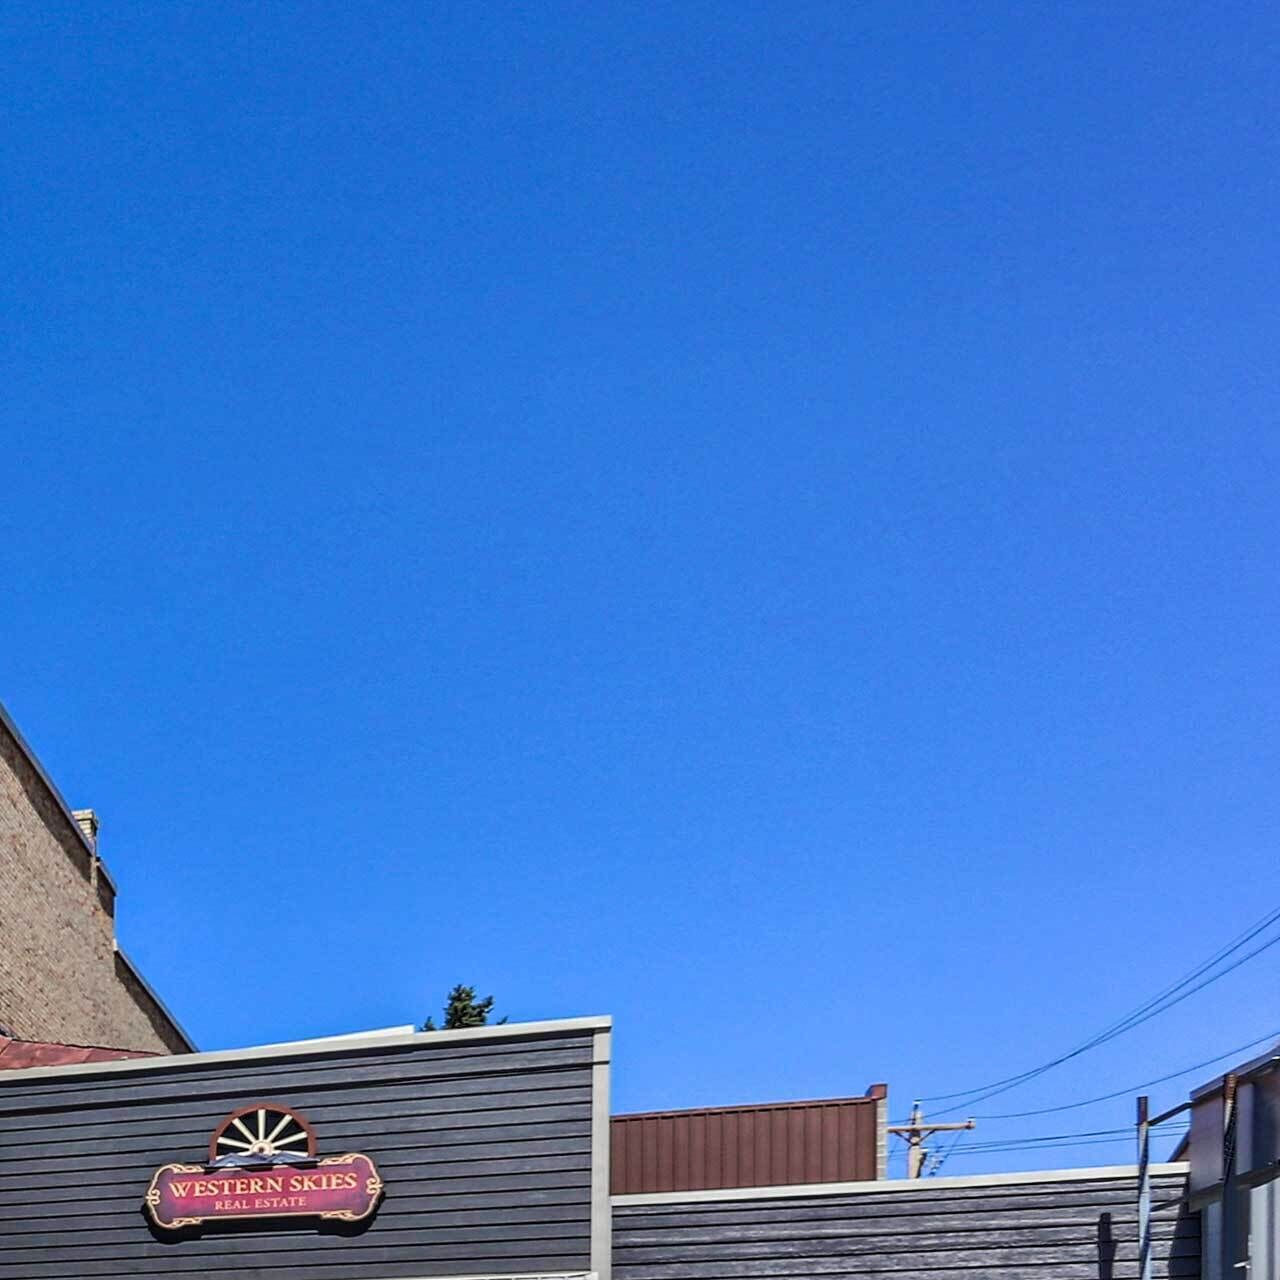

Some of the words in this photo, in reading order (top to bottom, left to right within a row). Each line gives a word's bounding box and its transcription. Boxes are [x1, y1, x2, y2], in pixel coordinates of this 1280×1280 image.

[169, 1177, 282, 1198] WESTERN
[290, 1172, 357, 1191] SKIES
[215, 1199, 249, 1210] REAL
[255, 1196, 307, 1208] ESTATE
